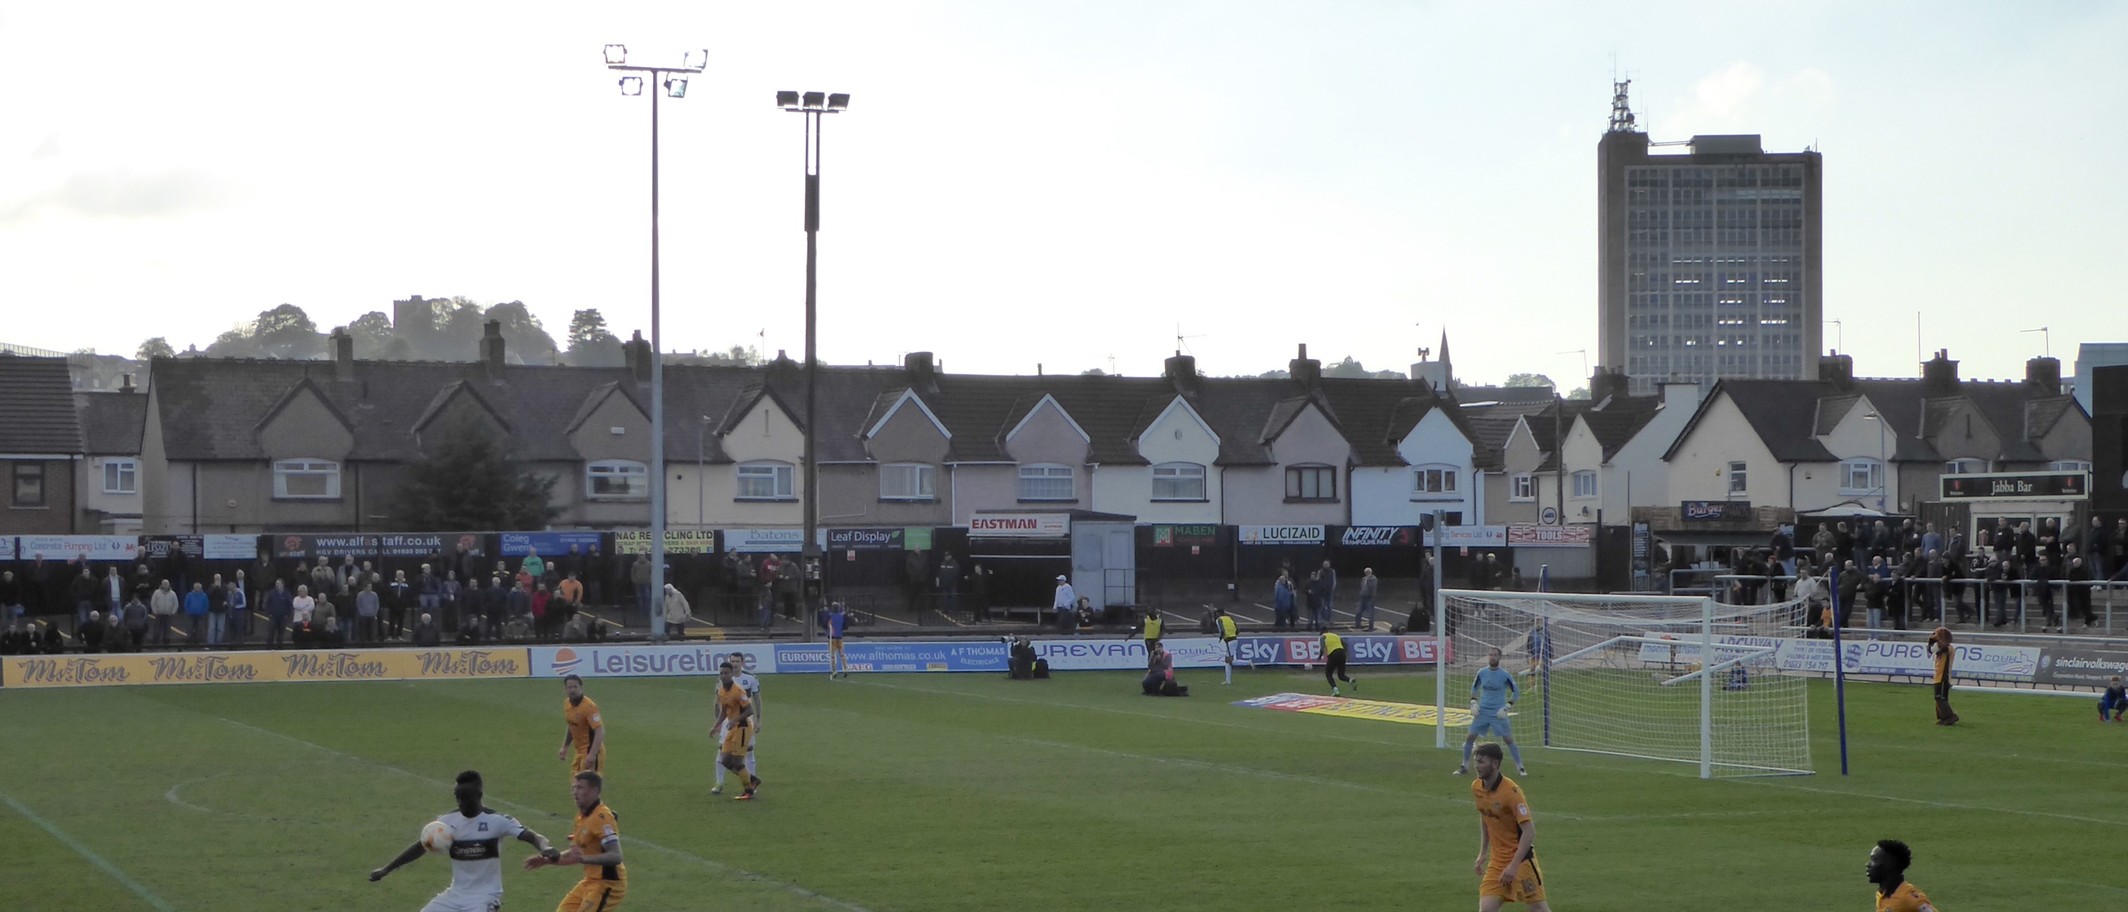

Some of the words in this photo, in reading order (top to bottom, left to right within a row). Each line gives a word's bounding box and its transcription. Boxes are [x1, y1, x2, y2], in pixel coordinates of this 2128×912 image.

[1991, 480, 2014, 495] Jabba
[2017, 481, 2032, 492] Bar
[1688, 503, 1724, 516] Burger
[972, 519, 1037, 529] EASTMAN
[616, 531, 635, 540] NAG
[638, 531, 693, 540] RECLING
[696, 531, 713, 539] LTD
[1175, 526, 1216, 535] MABEN
[1263, 527, 1320, 539] LUCIZAID
[1343, 527, 1400, 540] INFINITY
[1536, 531, 1563, 540] TOOLS
[503, 534, 529, 545] Coleg
[831, 531, 852, 542] Leaf
[854, 531, 891, 544] Display
[30, 542, 62, 550] Concrete
[64, 542, 92, 551] Pumping
[94, 542, 107, 550] Ltd
[950, 648, 957, 656] A
[967, 646, 1005, 656] THOMAS
[1240, 639, 1280, 663] sky
[1290, 641, 1322, 660] BE
[1352, 638, 1392, 663] sky
[464, 651, 519, 675] Tom
[781, 653, 832, 662] EURONICS
[960, 657, 1000, 666] ELECTRICALS
[69, 658, 130, 683] Tom
[201, 655, 258, 681] Tom
[331, 652, 387, 677] Tom
